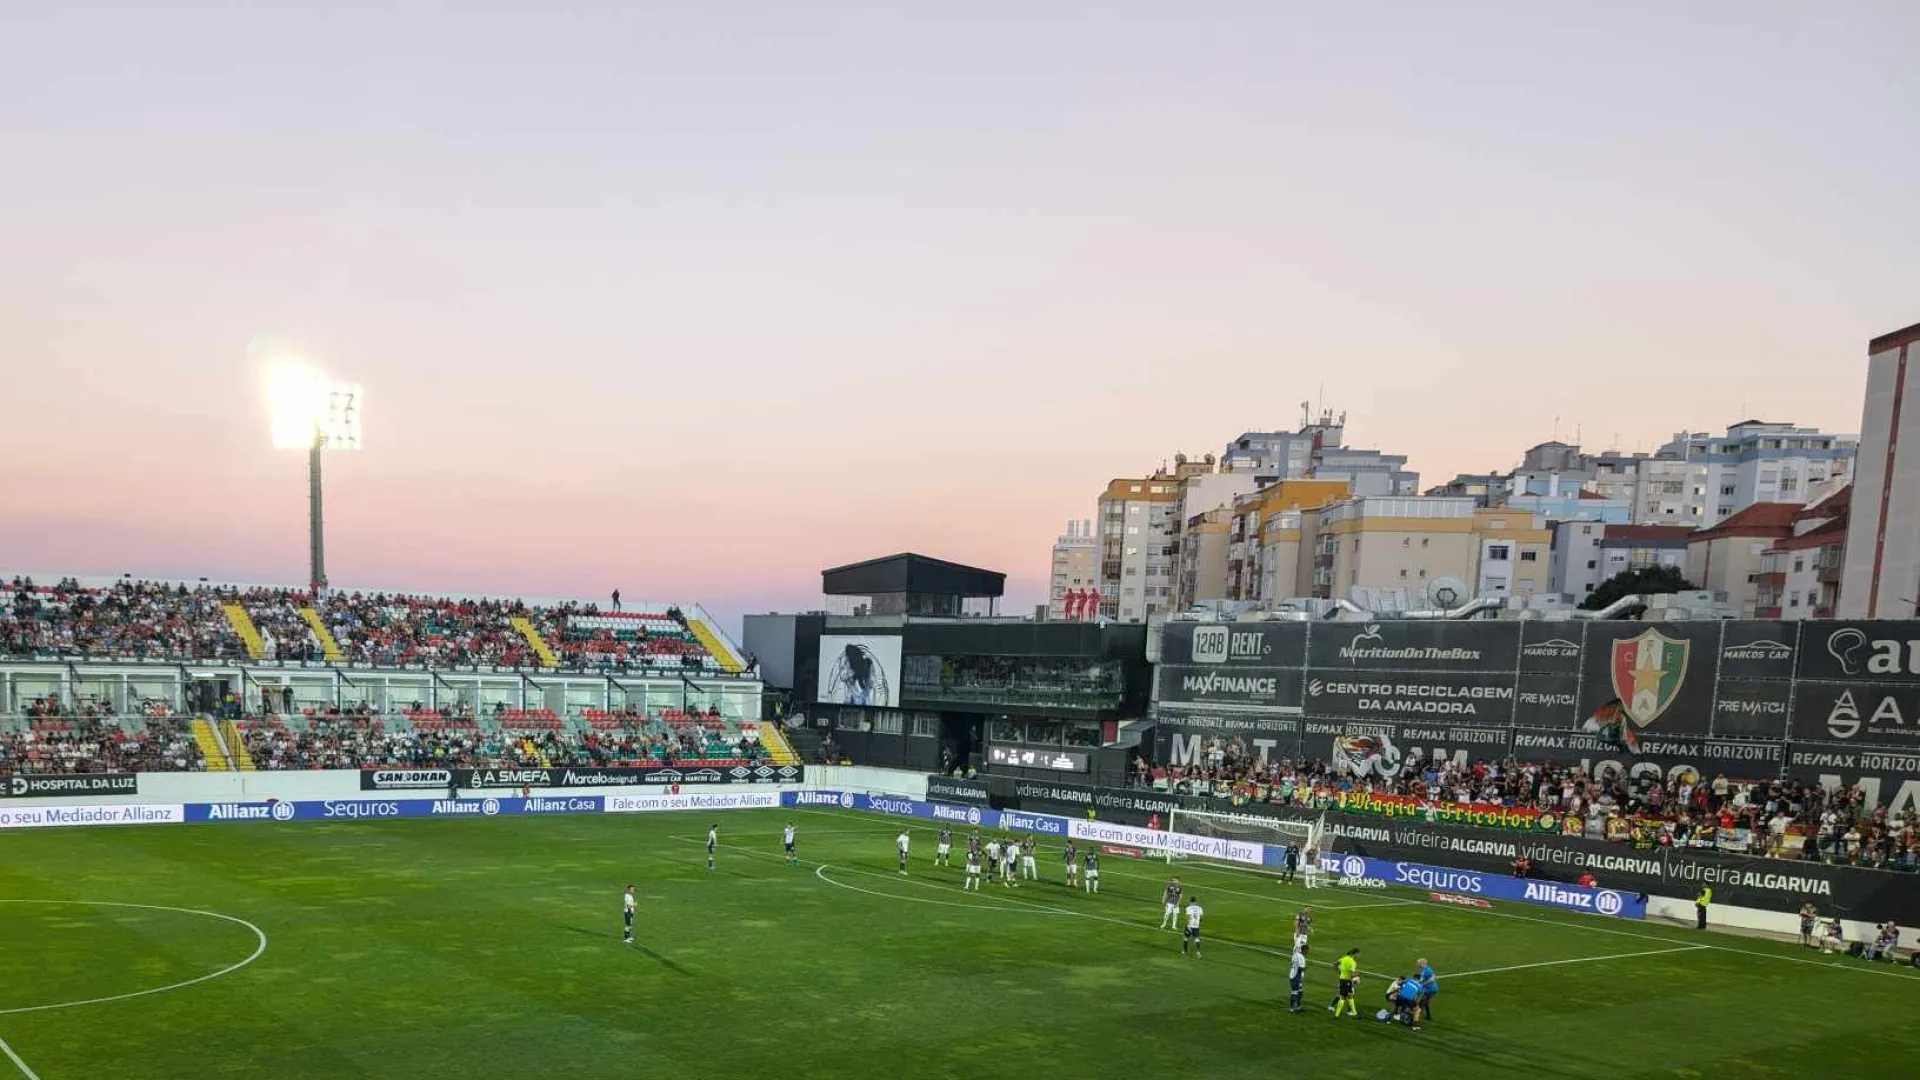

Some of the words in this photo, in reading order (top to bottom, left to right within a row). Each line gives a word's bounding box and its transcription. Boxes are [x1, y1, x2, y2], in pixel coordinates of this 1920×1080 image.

[1231, 632, 1265, 655] RENT
[1339, 646, 1480, 660] NutritionOnTheBox
[1524, 648, 1559, 656] MARCOS
[1561, 648, 1578, 657] CAR
[1723, 651, 1765, 659] MARCOS
[1768, 651, 1789, 660] CAR
[1183, 671, 1276, 694] MAXFINANCE
[1326, 683, 1392, 695] CENTRO
[1396, 684, 1514, 699] RECICLAGEM
[1359, 700, 1381, 710] DA
[1384, 701, 1476, 715] AMADORA
[1519, 693, 1538, 703] PRE
[1540, 693, 1575, 706] MATCH
[1718, 701, 1739, 712] PRE
[1742, 701, 1786, 715] MATCH
[1306, 723, 1342, 734] RE/MAX
[1404, 729, 1446, 741] RE/MAX
[1450, 729, 1506, 744] HORIZONTE
[1515, 734, 1564, 748] RE/MAX
[1642, 742, 1698, 756] RE/MAX
[1704, 745, 1780, 761] HORIZONTE
[1792, 752, 1854, 768] RE/MAX
[1861, 755, 1920, 772] HORIZO
[485, 771, 495, 781] A
[499, 770, 551, 782] SMEFA
[30, 779, 90, 791] HOSPITAL
[93, 779, 110, 789] DA
[112, 778, 136, 789] LUZ
[525, 798, 566, 812] Allianz
[568, 798, 595, 811] Casa
[613, 797, 634, 809] Fale
[636, 800, 659, 809] com
[661, 800, 667, 808] o
[670, 799, 688, 808] seu
[690, 794, 736, 807] Mediador
[740, 794, 773, 806] Allianz
[796, 792, 838, 805] Allianz
[869, 797, 912, 814] Seguros
[208, 804, 270, 819] Allianz
[324, 800, 399, 818] Seguros
[432, 801, 480, 813] Allianz
[934, 805, 967, 821] Allianz
[1, 813, 10, 824] o
[14, 811, 41, 824] seu
[46, 808, 118, 823] Mediador
[122, 807, 172, 821] Allianz
[999, 813, 1034, 829] Allianz
[1036, 818, 1060, 833] Casa
[1016, 783, 1049, 798] vidreira
[1051, 788, 1092, 803] ALGARVIA
[1095, 793, 1132, 809] vidreira
[1134, 799, 1179, 813] ALGARVIA
[1333, 826, 1390, 842] ALGARVIA
[1395, 827, 1449, 849] vidreira
[1450, 838, 1516, 857] ALGARVIA
[1522, 842, 1585, 866] vidreira
[1586, 854, 1661, 876] ALGARVIA
[1668, 859, 1741, 885] vidreira
[1742, 872, 1831, 895] ALGARVIA
[1076, 823, 1097, 837] Fale
[1100, 828, 1123, 841] com
[1125, 832, 1132, 842] o
[1139, 833, 1157, 845] seu
[1212, 840, 1253, 860] Allianz
[1396, 862, 1482, 894] Seguros
[1524, 882, 1592, 907] Allianz
